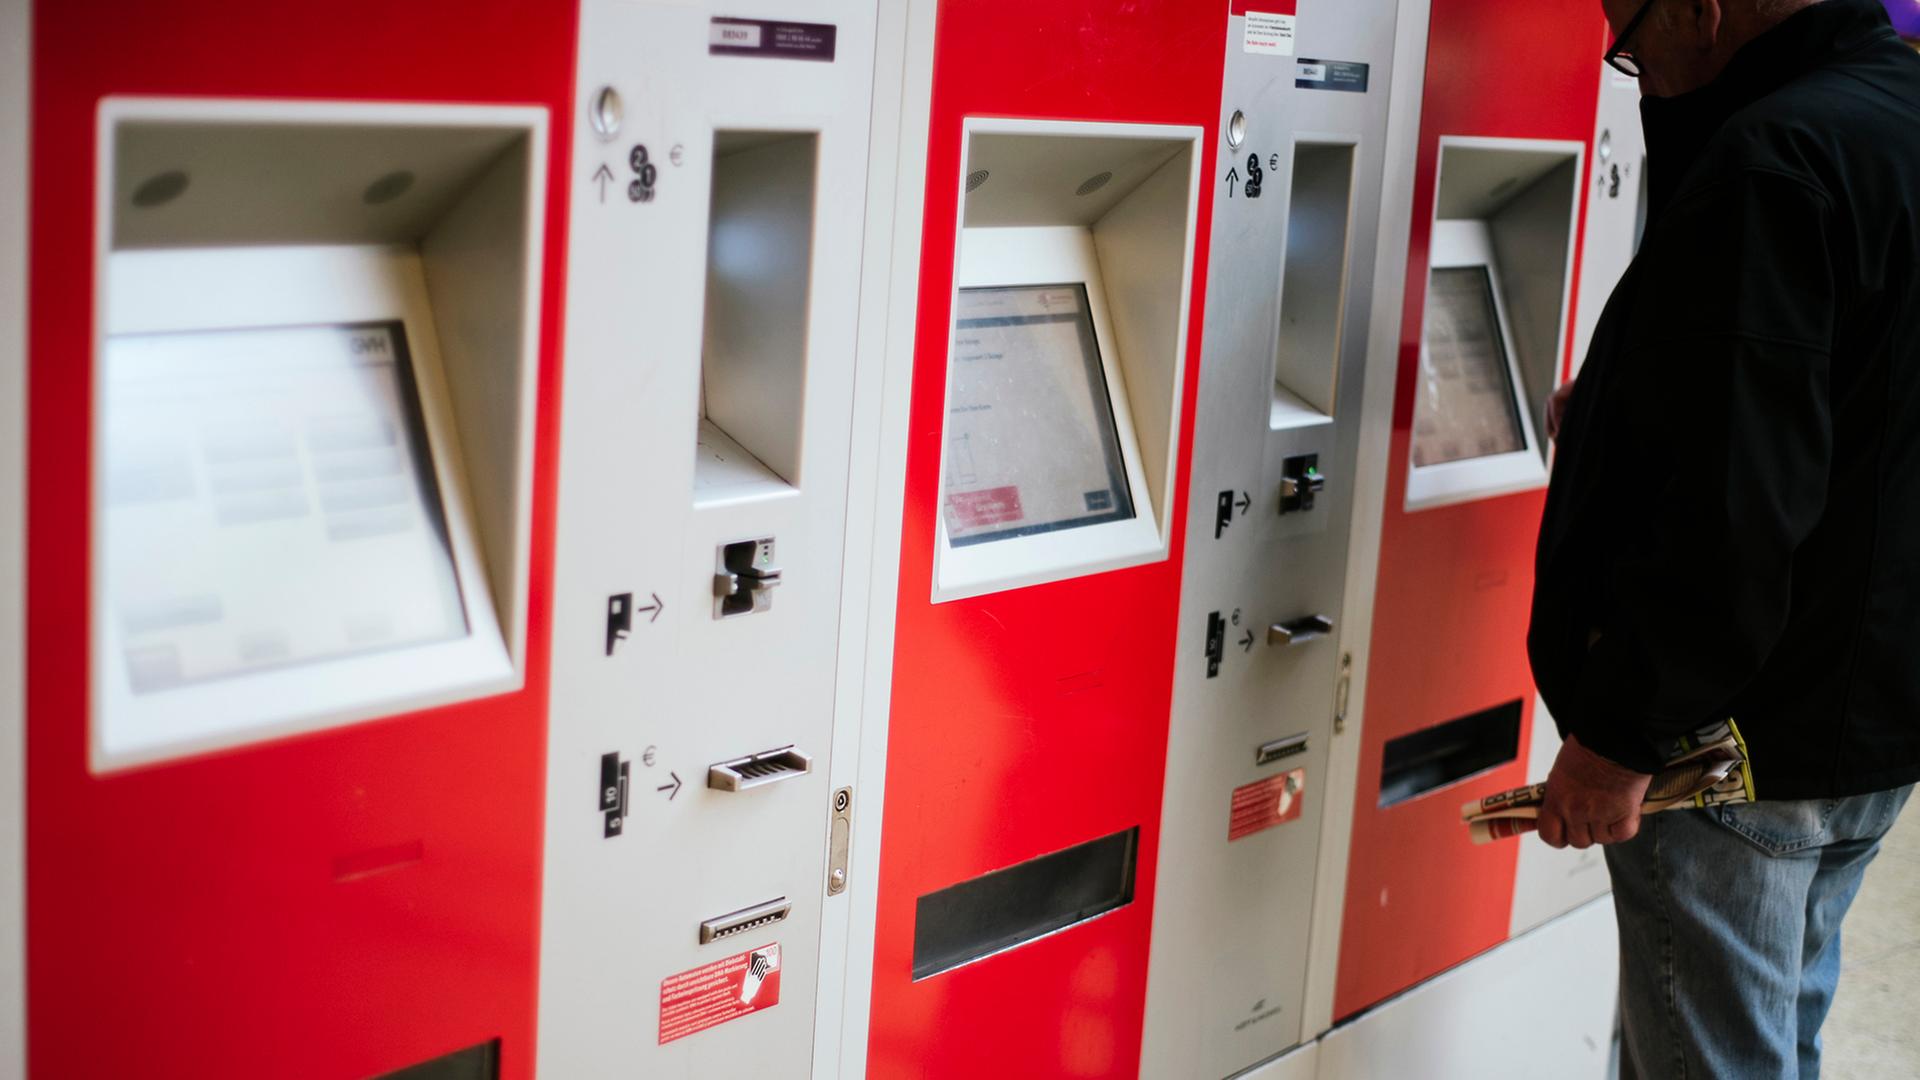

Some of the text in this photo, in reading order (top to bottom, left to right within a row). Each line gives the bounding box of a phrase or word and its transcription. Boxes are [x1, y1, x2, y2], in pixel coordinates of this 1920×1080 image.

[1269, 153, 1279, 171] €
[642, 745, 657, 767] €
[606, 787, 617, 803] 10
[610, 818, 621, 828] 5
